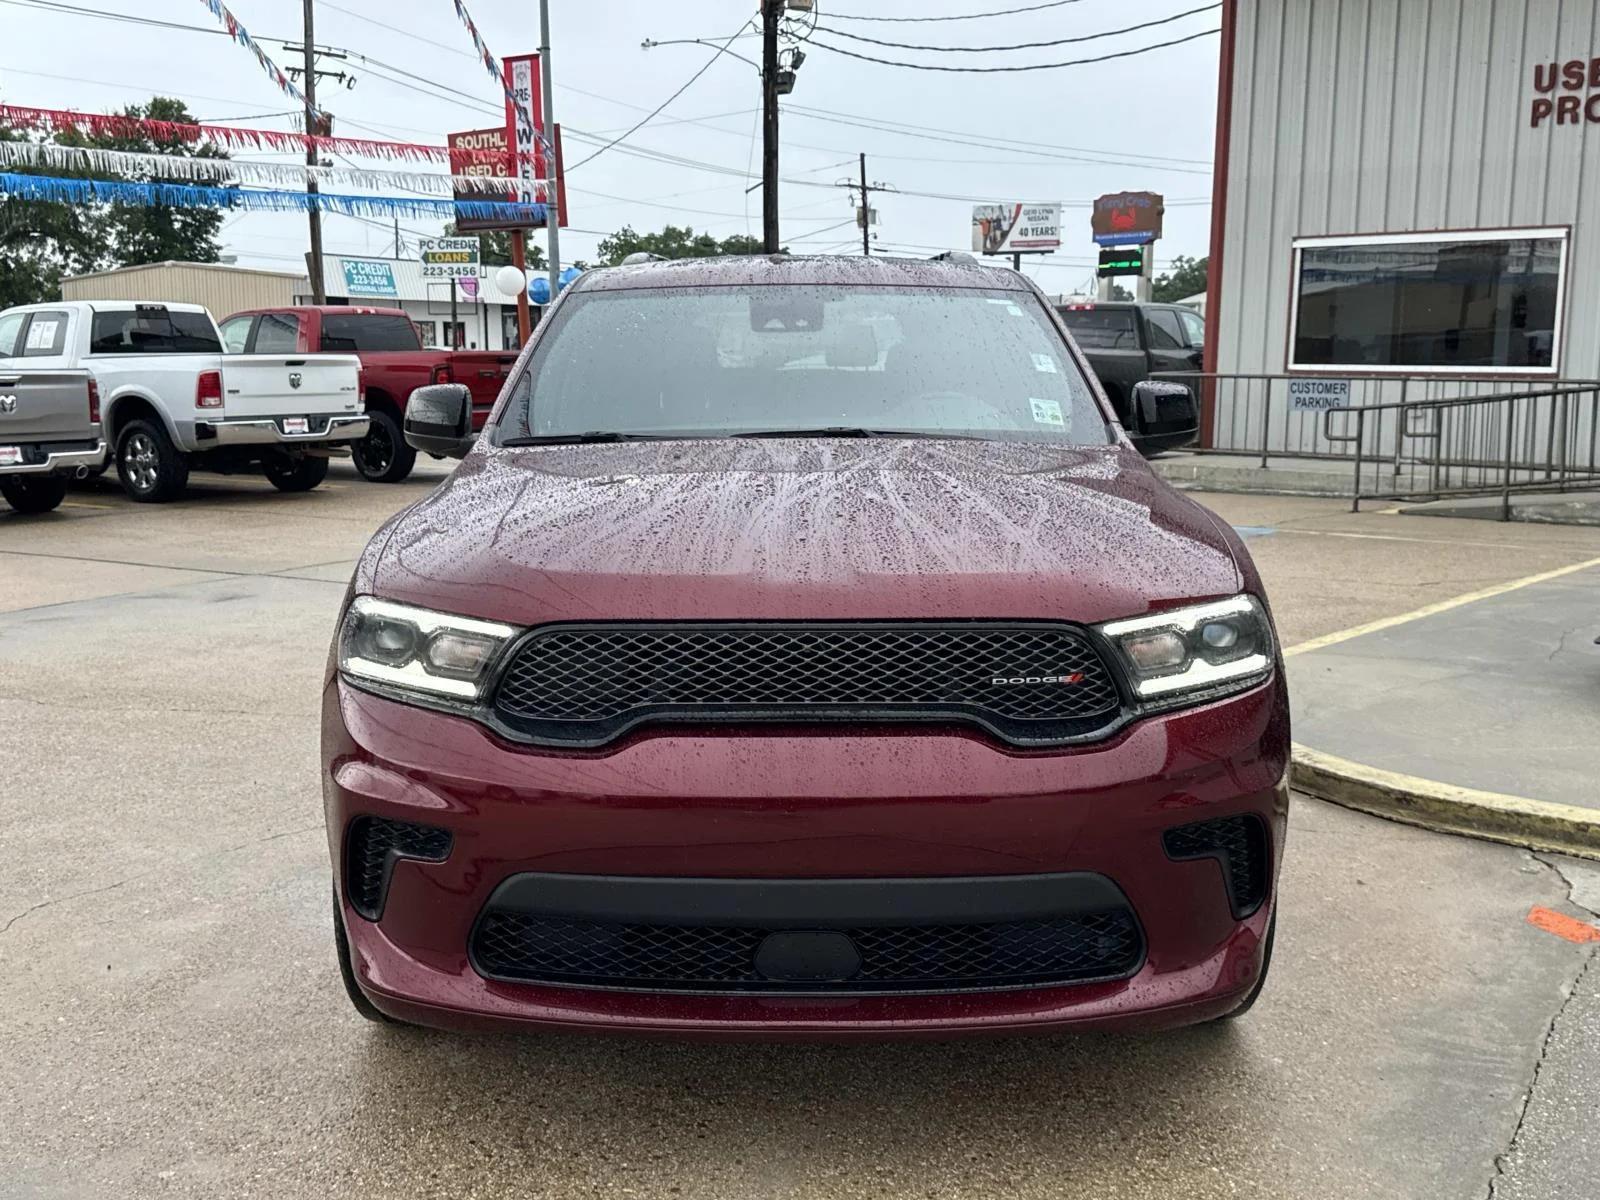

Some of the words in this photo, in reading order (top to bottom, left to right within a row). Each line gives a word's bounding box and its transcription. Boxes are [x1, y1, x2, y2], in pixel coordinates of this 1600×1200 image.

[459, 164, 492, 177] USED
[496, 162, 508, 177] C
[1019, 227, 1029, 237] 40
[1030, 226, 1057, 237] YEARS!
[419, 240, 435, 250] PC
[437, 239, 478, 250] CREDIT
[428, 252, 470, 263] LOANS
[343, 261, 357, 274] PC
[357, 262, 391, 276] CREDIT
[352, 274, 388, 286] 223-3456
[1290, 382, 1347, 395] CUSTOMER
[1295, 396, 1340, 409] PARKING
[992, 674, 1073, 685] DODGE
